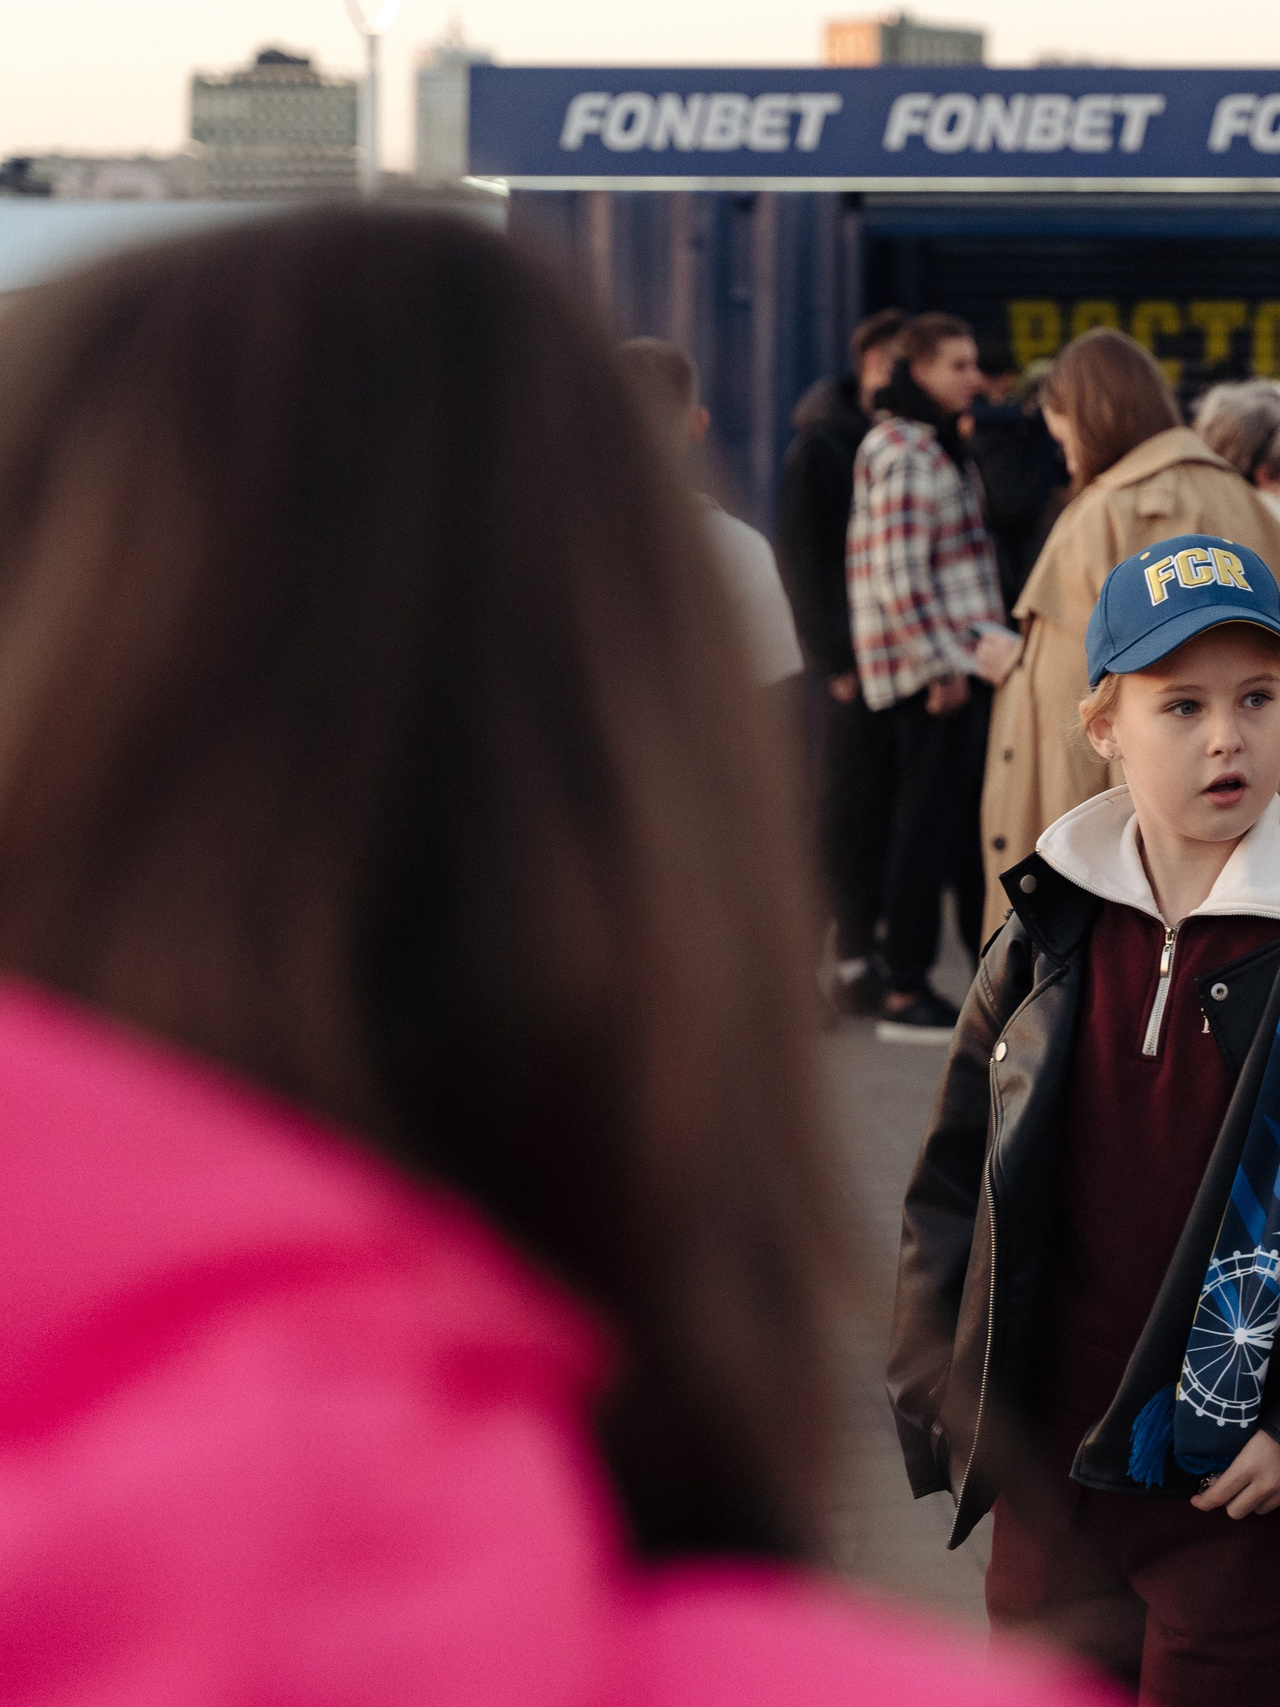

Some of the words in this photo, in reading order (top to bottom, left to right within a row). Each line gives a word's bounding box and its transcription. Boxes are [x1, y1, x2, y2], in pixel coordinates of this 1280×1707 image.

[560, 93, 842, 152] FONBET
[884, 93, 1164, 153] FONBET
[1144, 547, 1254, 606] FCR
